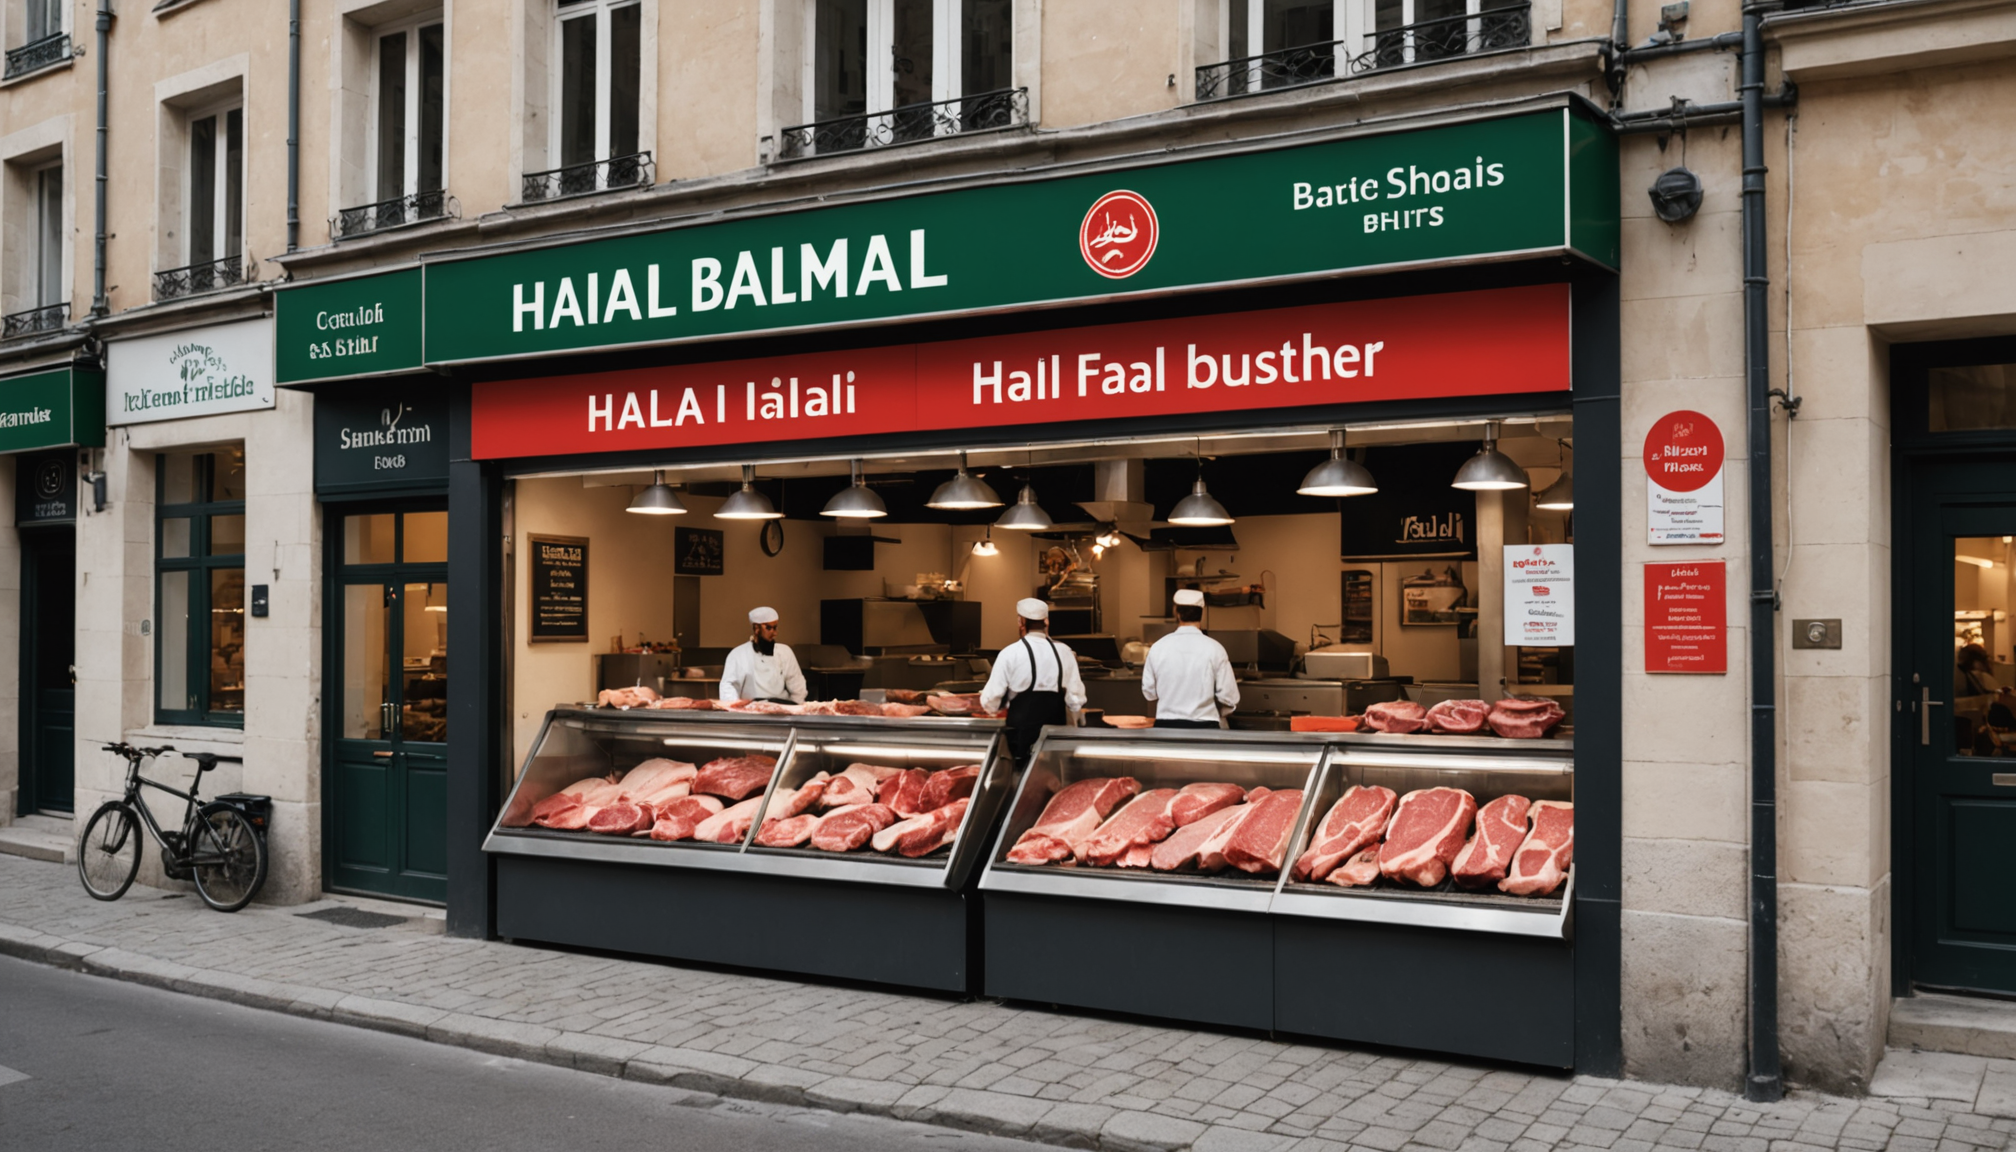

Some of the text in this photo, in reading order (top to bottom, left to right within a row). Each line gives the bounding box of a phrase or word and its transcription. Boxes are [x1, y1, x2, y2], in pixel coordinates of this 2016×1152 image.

[1386, 155, 1505, 199] Shoais
[691, 228, 948, 313] BALMAL
[1077, 346, 1165, 397] Faal
[1187, 332, 1384, 389] busther
[588, 387, 705, 433] HALA
